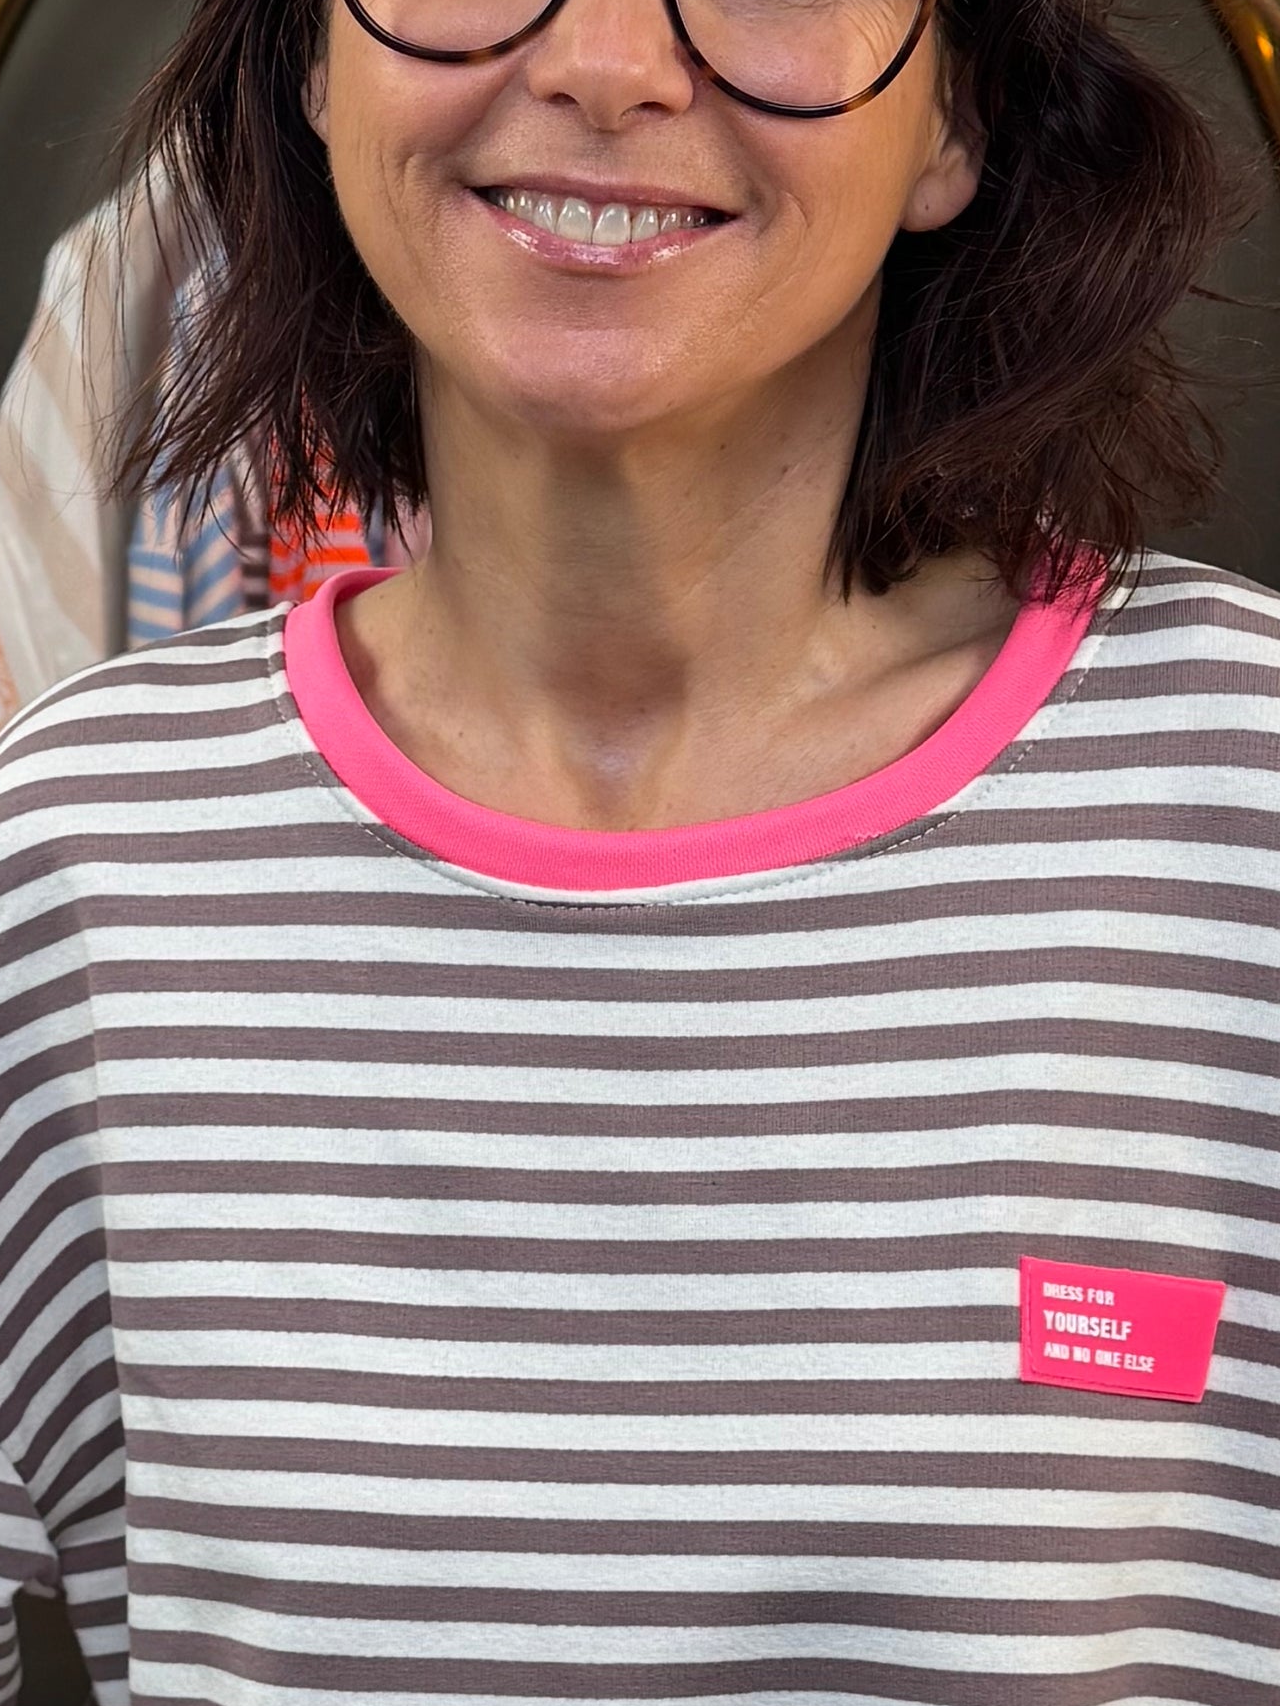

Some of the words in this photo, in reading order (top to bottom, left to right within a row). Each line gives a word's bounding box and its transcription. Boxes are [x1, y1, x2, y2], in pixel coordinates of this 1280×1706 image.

[1043, 1282, 1083, 1302] DRESS
[1087, 1288, 1114, 1305] FOR
[1043, 1310, 1131, 1340] YOURSELF
[1044, 1342, 1069, 1359] AND
[1072, 1346, 1091, 1363] NO
[1095, 1349, 1121, 1367] ONE
[1123, 1354, 1154, 1372] ELSE
